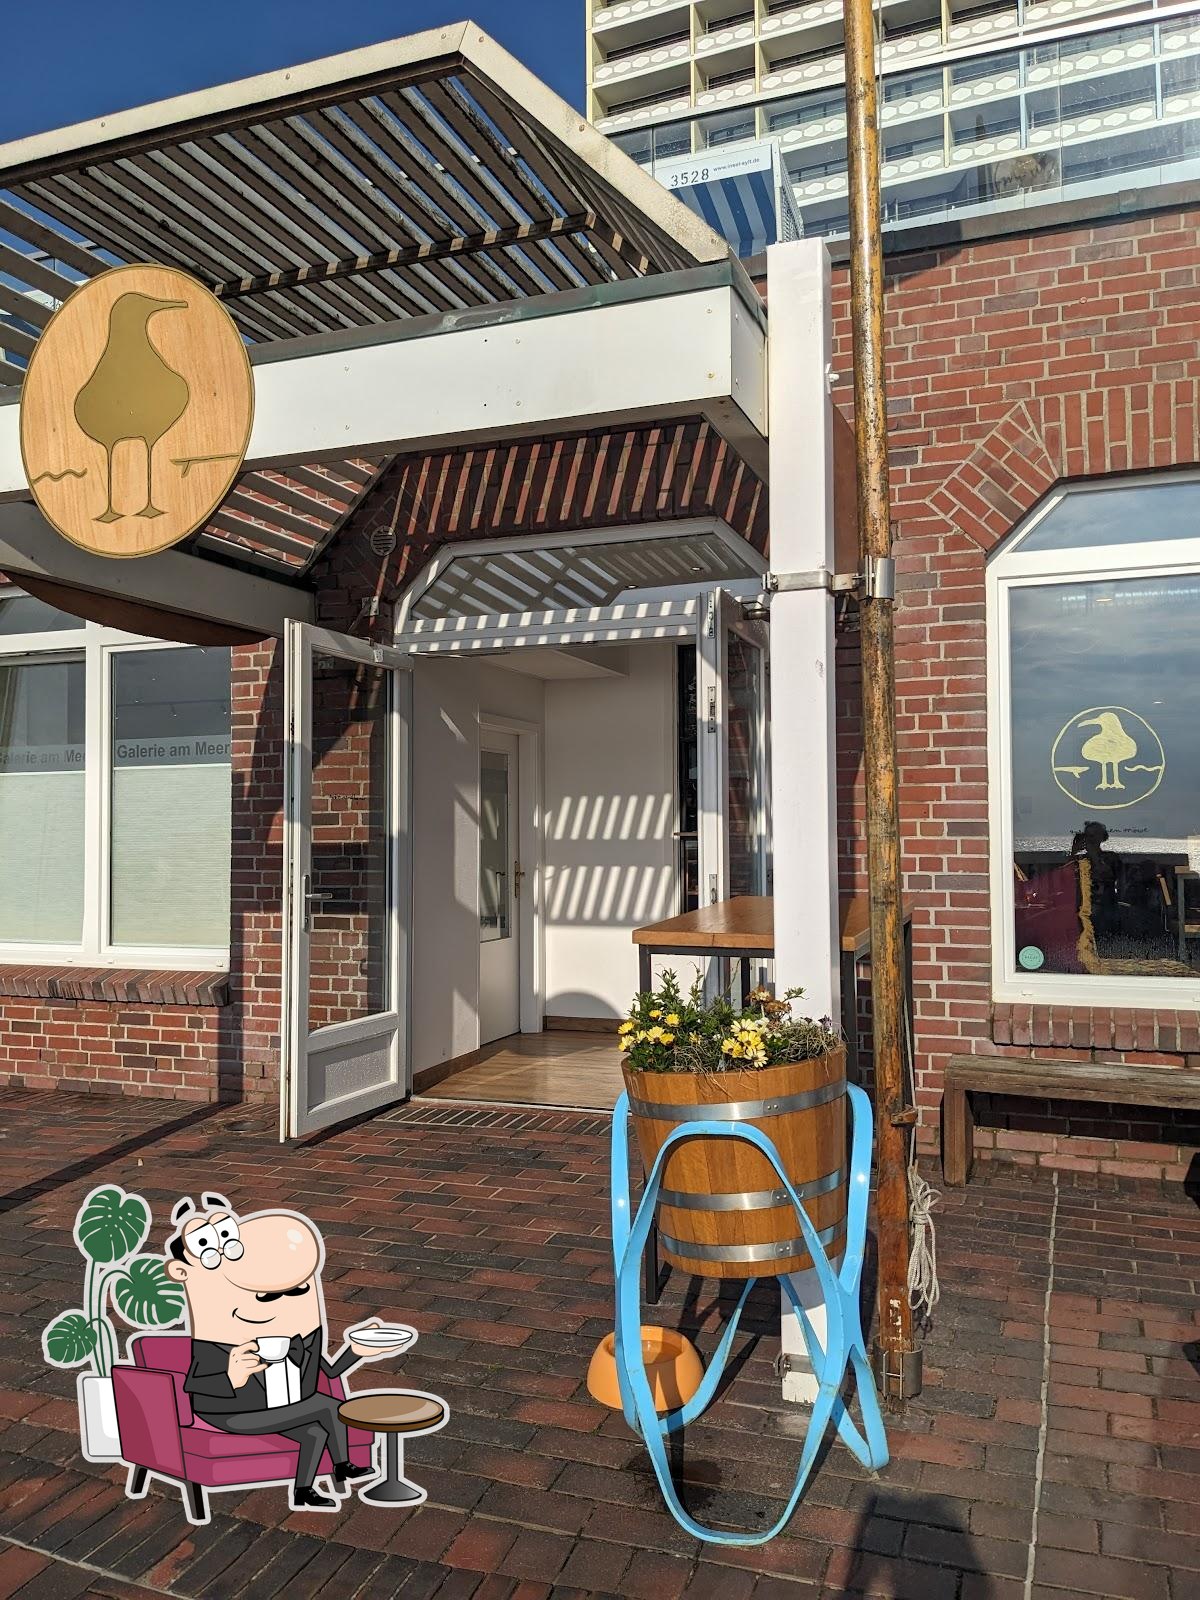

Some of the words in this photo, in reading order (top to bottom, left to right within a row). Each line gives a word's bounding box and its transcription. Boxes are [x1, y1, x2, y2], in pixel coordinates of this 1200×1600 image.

[670, 168, 709, 187] 3528
[0, 751, 38, 764] alerie
[117, 744, 166, 759] Galerie
[169, 745, 191, 757] am
[195, 741, 231, 756] Meer
